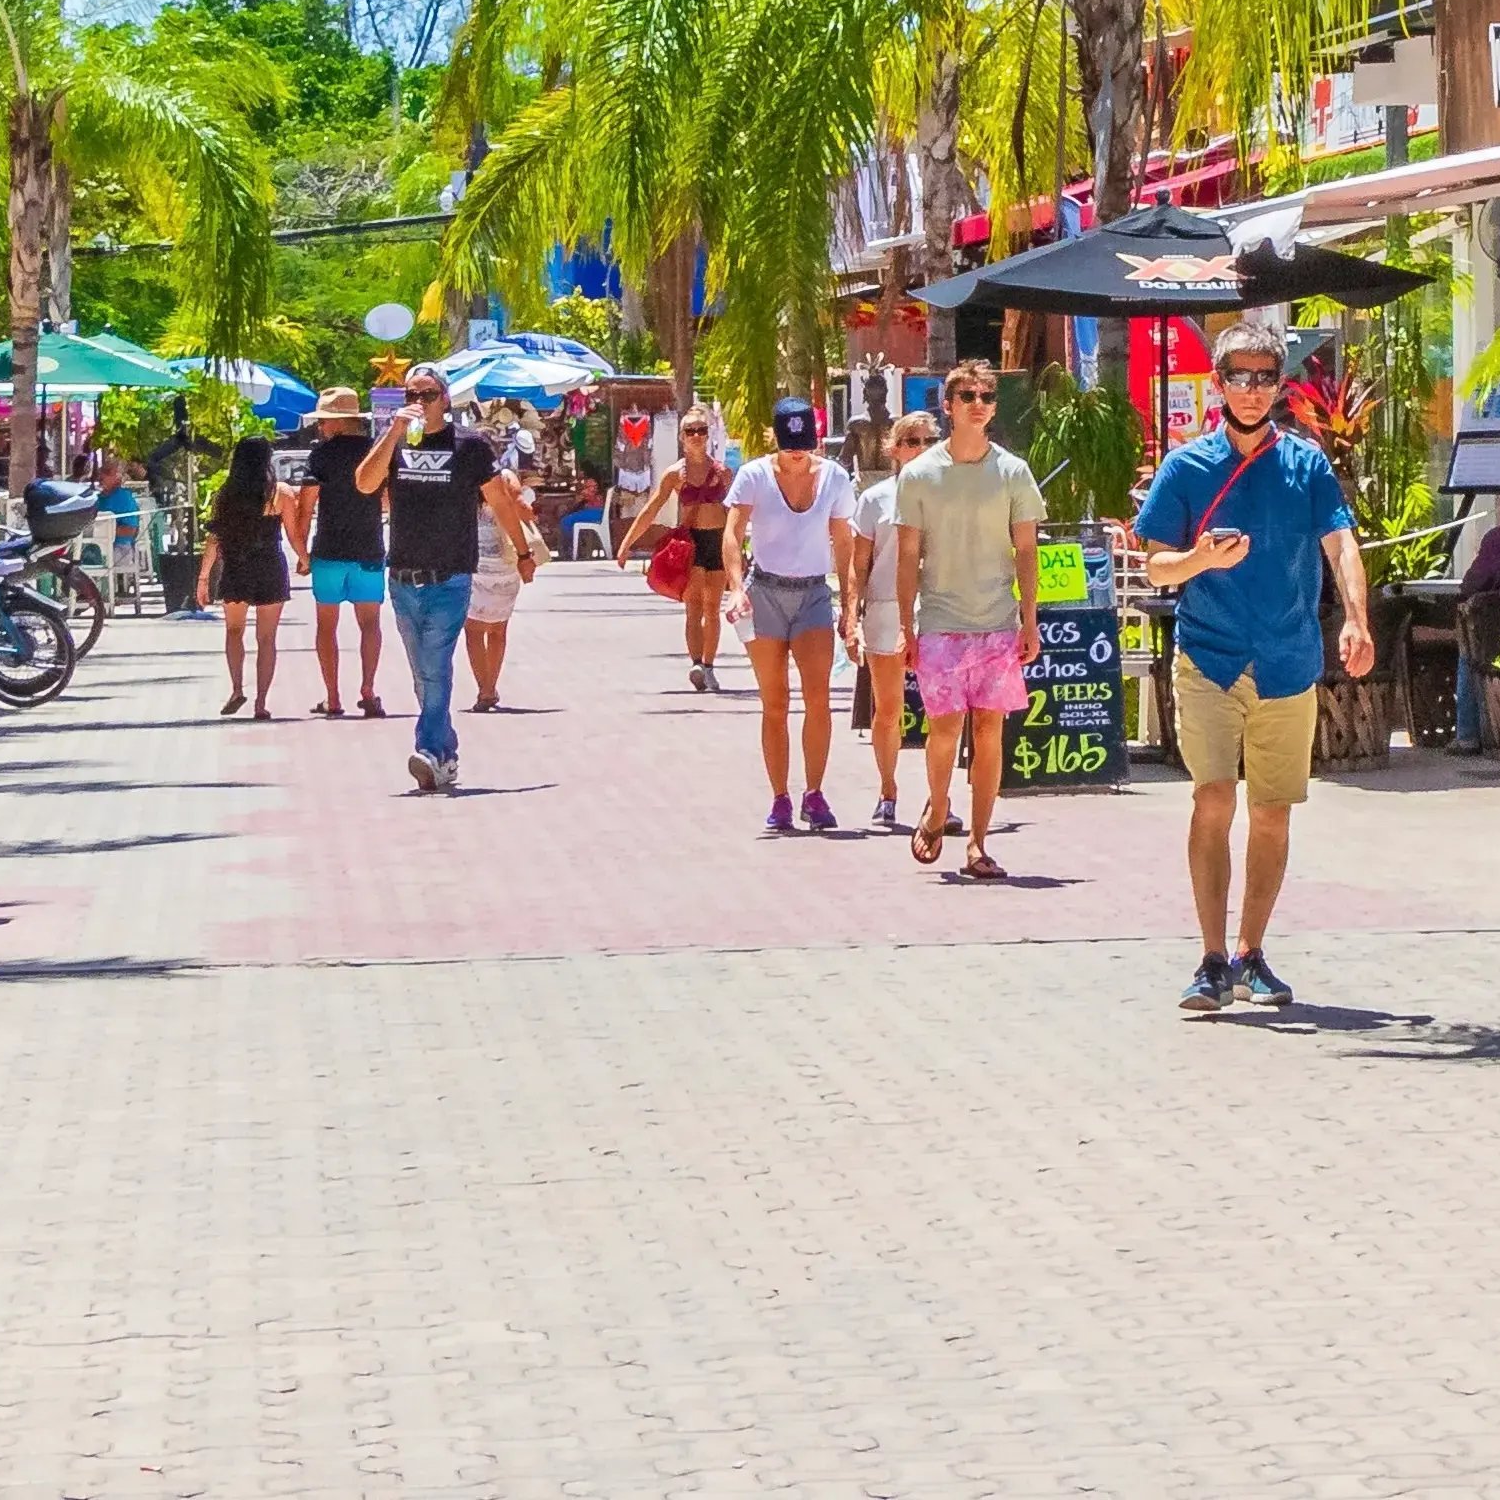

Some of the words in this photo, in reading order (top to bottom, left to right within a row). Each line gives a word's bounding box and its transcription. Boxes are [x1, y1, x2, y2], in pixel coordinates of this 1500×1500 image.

[1138, 280, 1181, 291] DOS
[1040, 550, 1077, 569] DAY
[1037, 621, 1081, 644] RGS
[1089, 631, 1113, 664] Ó
[1023, 654, 1088, 679] chos
[1023, 690, 1053, 727] 2
[1052, 682, 1113, 702] BEERS
[1064, 702, 1103, 711] INDIO
[1058, 718, 1111, 727] TECATE
[1012, 733, 1107, 779] $165
